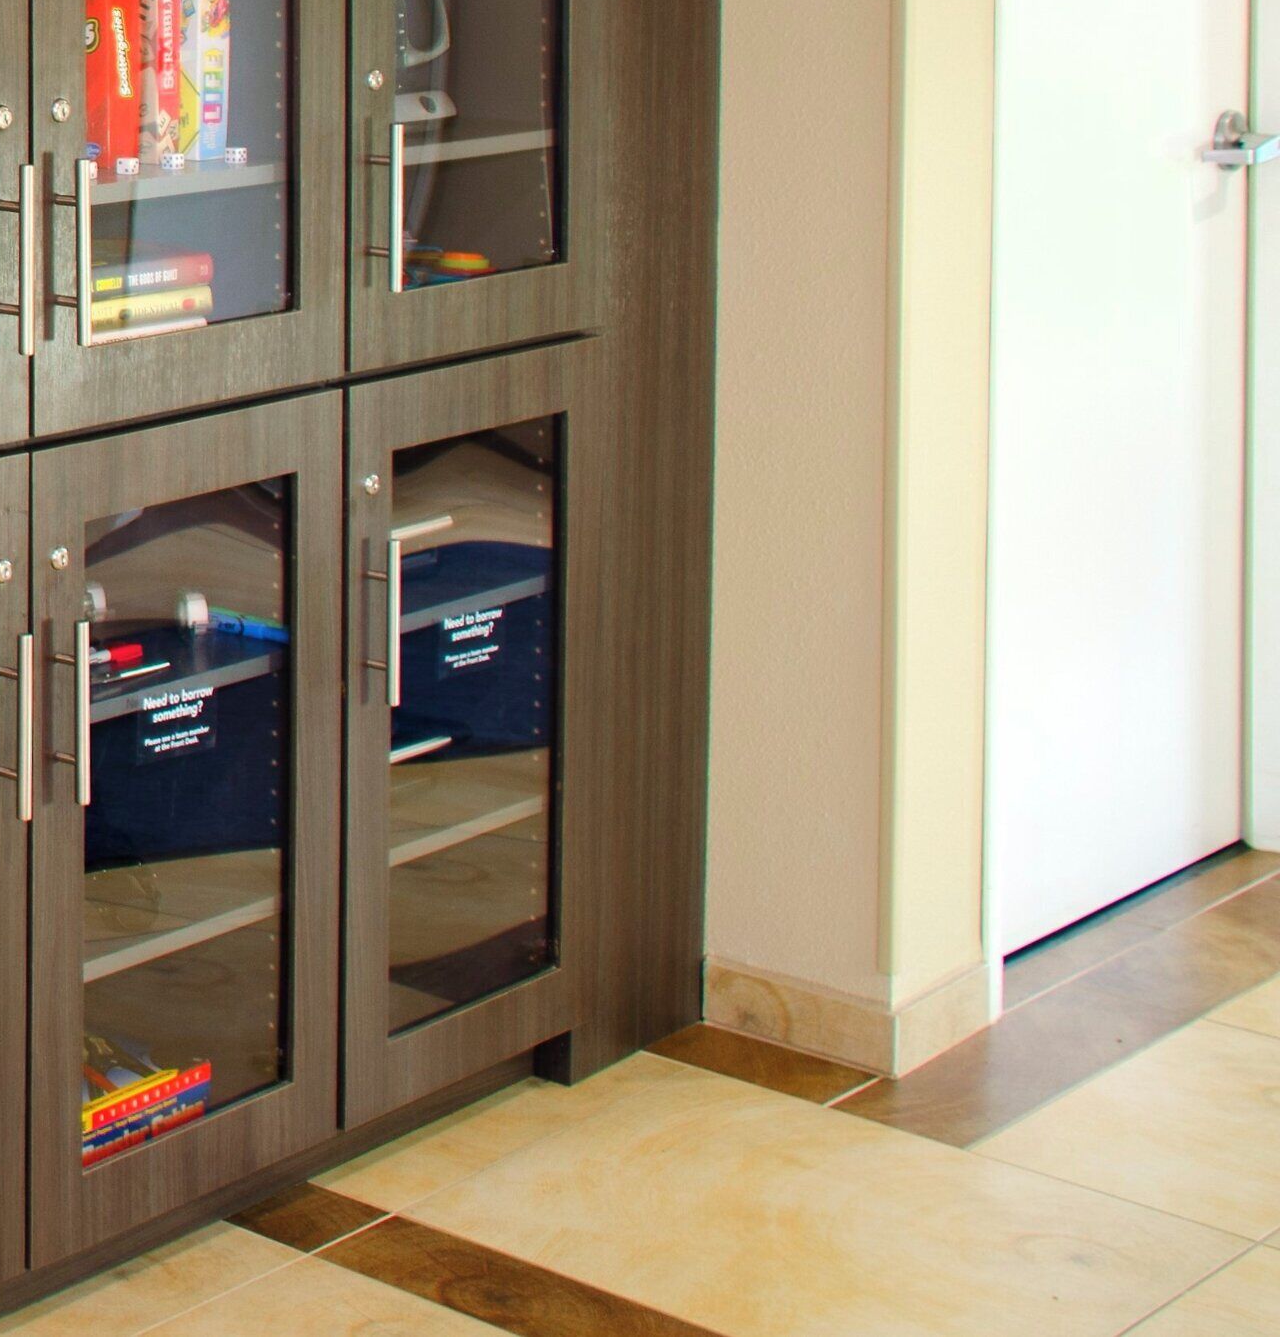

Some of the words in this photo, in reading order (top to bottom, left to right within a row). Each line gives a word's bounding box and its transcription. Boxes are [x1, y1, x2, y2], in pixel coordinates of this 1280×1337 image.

[112, 8, 132, 97] Scattergories
[203, 52, 223, 123] LIFE
[128, 275, 138, 287] THE
[155, 271, 162, 283] OF
[444, 614, 464, 630] Need
[465, 614, 475, 625] to
[475, 609, 503, 622] borrow
[451, 621, 494, 642] something?
[143, 692, 168, 711] Need
[169, 693, 180, 705] to
[181, 687, 214, 702] borrow
[153, 700, 203, 723] something?
